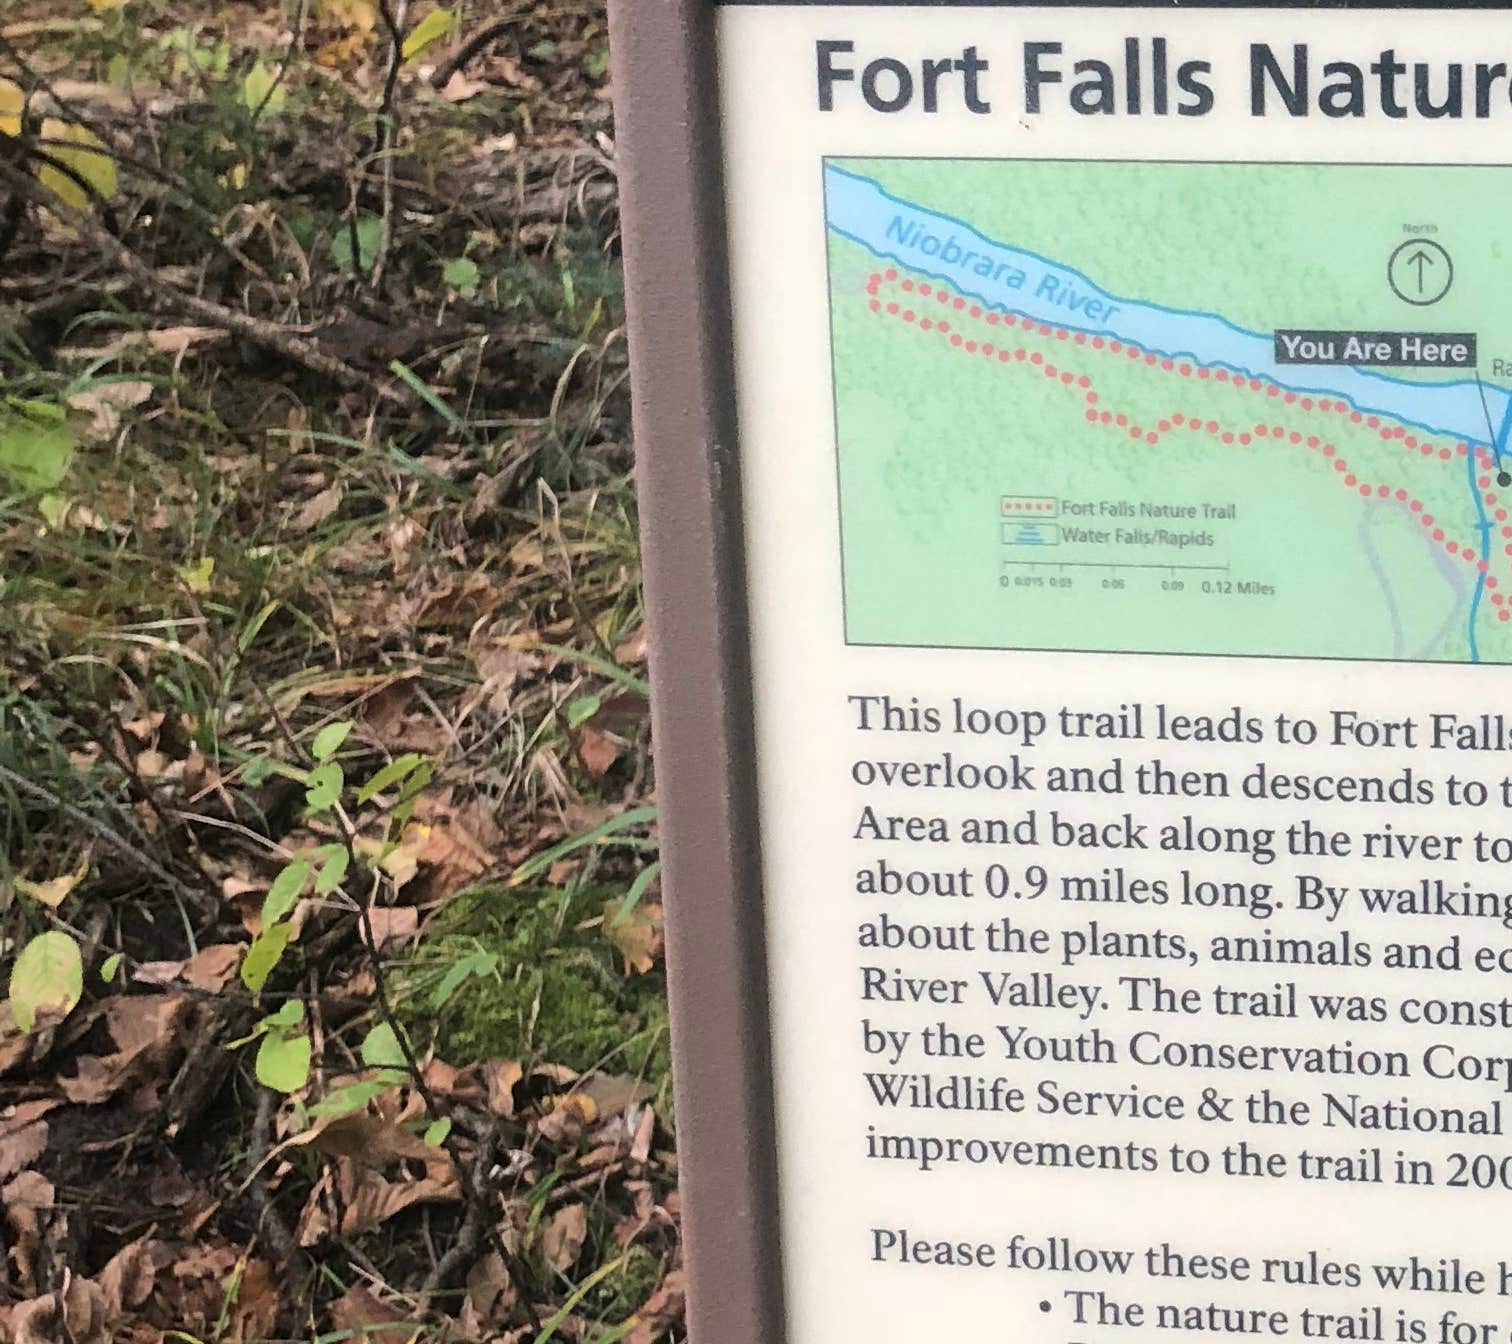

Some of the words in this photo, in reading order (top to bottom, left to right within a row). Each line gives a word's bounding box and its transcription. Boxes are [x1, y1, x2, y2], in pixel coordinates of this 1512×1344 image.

[816, 40, 991, 114] Fort
[1024, 37, 1214, 116] Falls
[885, 216, 1026, 290] Niobrara
[1035, 274, 1121, 324] River
[1281, 335, 1335, 360] You
[1343, 336, 1392, 361] Are
[1401, 337, 1468, 362] Here
[1061, 500, 1095, 516] Fort
[1100, 500, 1135, 517] Falls
[1140, 502, 1197, 518] Nature
[1202, 503, 1236, 520] Trail
[1061, 527, 1110, 544] Water
[1115, 528, 1215, 549] Falls/Rapids
[1201, 581, 1232, 594] 0.12
[1238, 582, 1276, 595] Miles
[848, 696, 941, 733] This
[953, 698, 1046, 746] loop
[1058, 704, 1144, 738] trail
[1156, 704, 1263, 743] leads
[1275, 714, 1317, 745] to
[1330, 711, 1418, 748] Fort
[852, 753, 1036, 790] overlook
[1047, 758, 1124, 793] and
[1135, 760, 1229, 797] then
[1242, 763, 1434, 804] descends
[1446, 775, 1487, 806] to
[853, 806, 950, 842] Area
[962, 810, 1039, 845] and
[1050, 811, 1148, 849] back
[1160, 816, 1276, 865] along
[1286, 820, 1351, 856] the
[1363, 824, 1462, 860] river
[856, 859, 973, 897] about
[985, 864, 1047, 899] 0.9
[1061, 868, 1169, 905] miles
[1181, 870, 1283, 919] long.
[1296, 876, 1349, 922] By
[860, 967, 968, 1003] River
[978, 971, 1108, 1020] Valley.
[1119, 977, 1201, 1014] The
[1213, 983, 1298, 1017] trail
[1309, 996, 1387, 1022] was
[861, 1019, 910, 1065] by
[921, 1022, 985, 1058] the
[996, 1026, 1117, 1063] Youth
[1130, 1032, 1411, 1077] Conservation
[866, 1125, 1158, 1171] improvements
[1169, 1144, 1209, 1174] to
[1222, 1142, 1286, 1178] the
[1298, 1148, 1383, 1183] trail
[1395, 1151, 1434, 1185] in
[871, 1229, 995, 1267] Please
[1007, 1235, 1134, 1274] follow
[1145, 1243, 1250, 1281] these
[1262, 1251, 1361, 1287] rules
[1372, 1256, 1485, 1294] while
[1064, 1291, 1144, 1326] The
[1157, 1303, 1288, 1335] nature
[1300, 1307, 1384, 1340] trail
[1396, 1310, 1426, 1343] is
